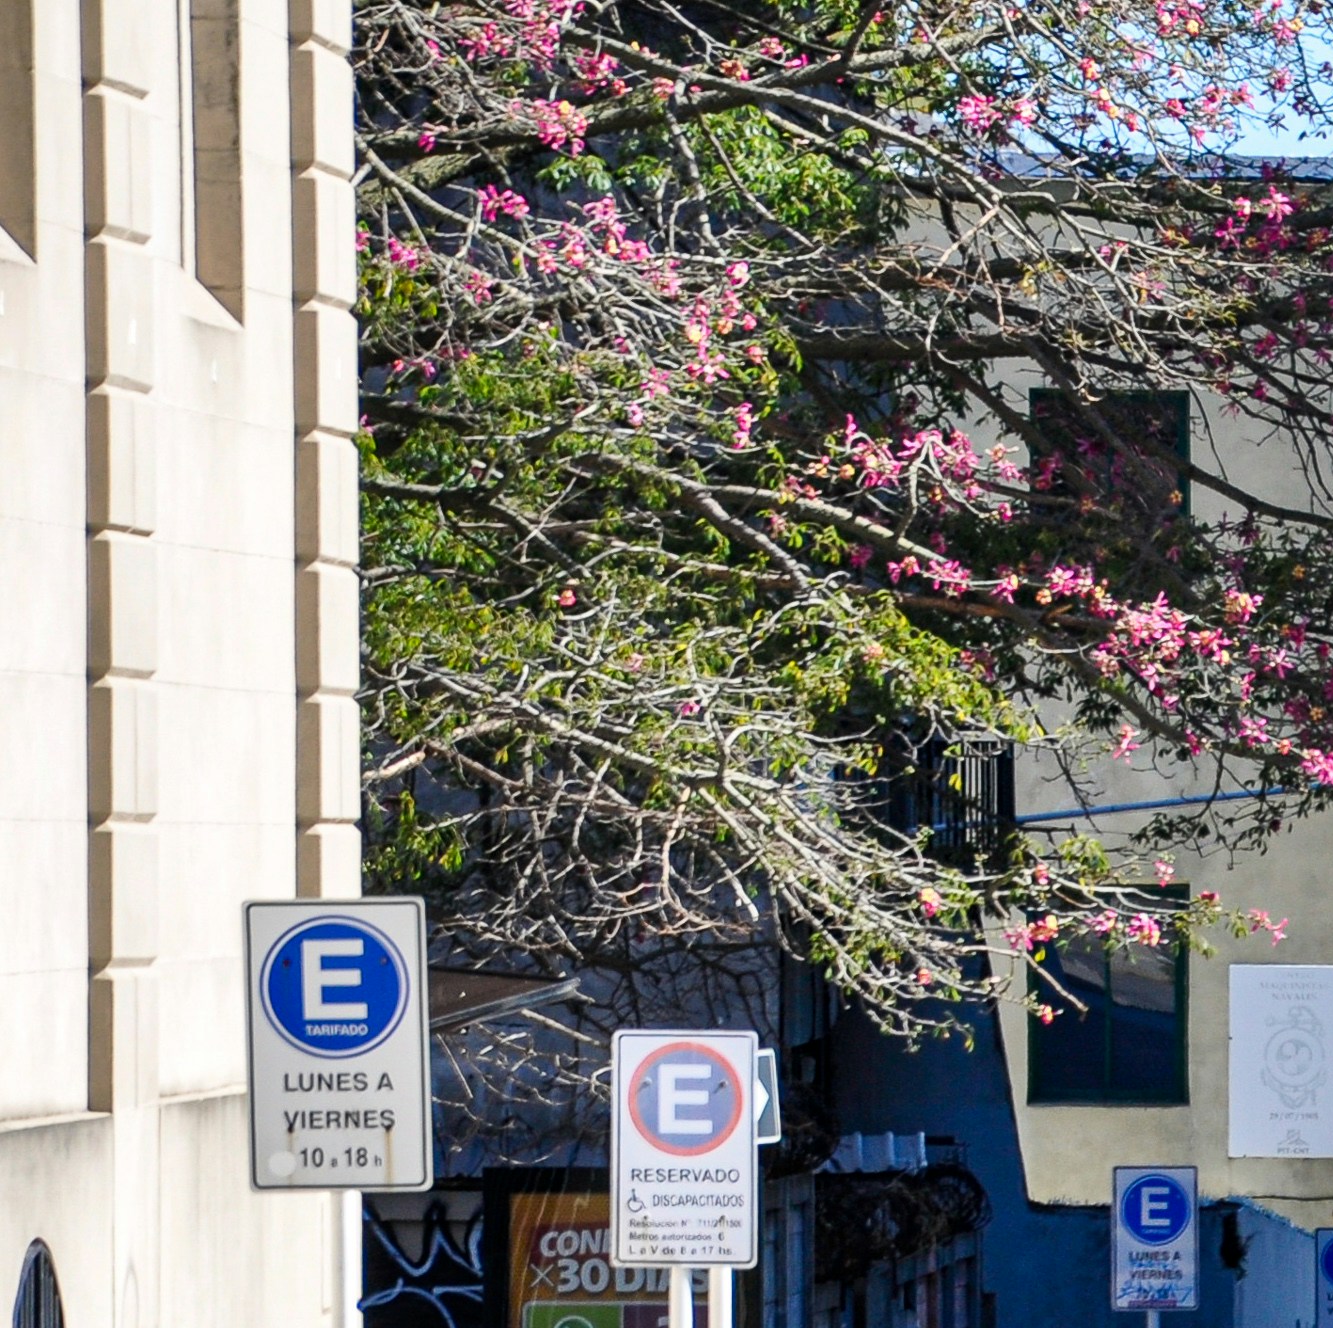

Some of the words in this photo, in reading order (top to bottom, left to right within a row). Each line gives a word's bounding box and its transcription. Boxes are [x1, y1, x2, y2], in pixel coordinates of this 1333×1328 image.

[302, 938, 369, 1020] E
[304, 1023, 369, 1036] TARIFADO
[283, 1072, 368, 1092] LUNES
[376, 1072, 394, 1091] A
[657, 1063, 713, 1135] E
[283, 1110, 396, 1130] VIERNES
[300, 1147, 324, 1168] 10
[344, 1146, 369, 1168] 18
[631, 1168, 740, 1183] RESERVADO
[652, 1194, 744, 1207] DISCAPACITADOS
[1141, 1186, 1171, 1226] E
[540, 1228, 611, 1258] CON
[1128, 1251, 1170, 1261] LUNES
[1130, 1270, 1183, 1280] VIERNES
